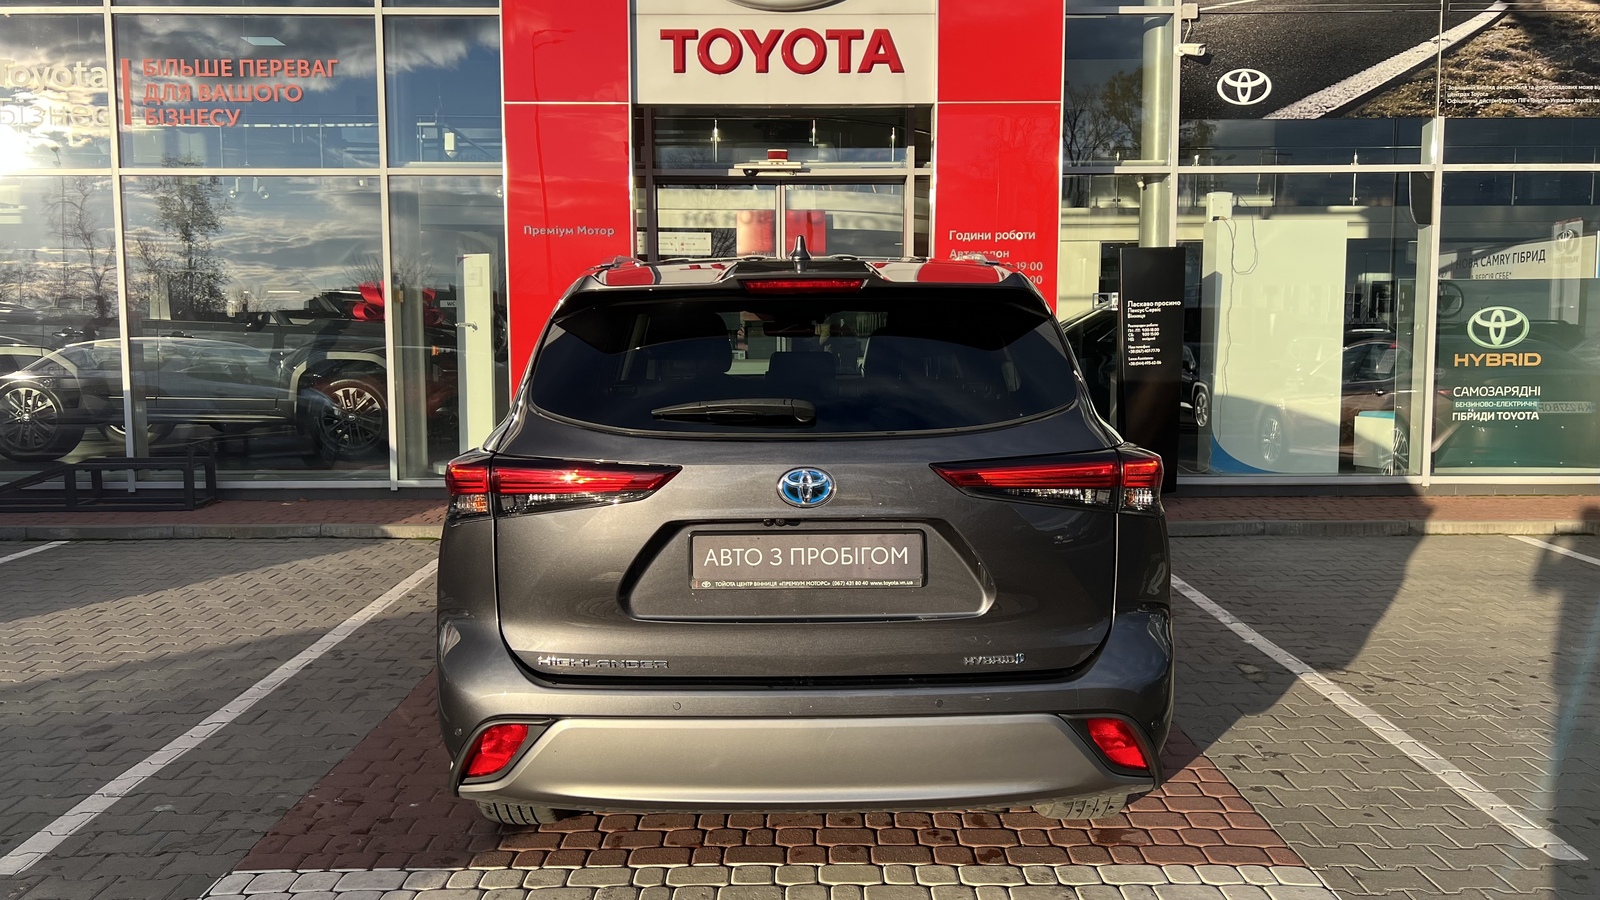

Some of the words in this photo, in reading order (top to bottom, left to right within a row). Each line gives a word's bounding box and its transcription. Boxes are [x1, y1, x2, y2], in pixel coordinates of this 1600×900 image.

[660, 28, 905, 75] TOYOTA
[142, 58, 233, 77] БІЛЬШЕ
[239, 59, 339, 77] ПЕРЕВАГ
[143, 83, 191, 105] ДЛЯ
[198, 84, 303, 102] ВАШОГО
[145, 108, 241, 127] БІЗНЕСУ
[523, 225, 574, 237] Преміум
[577, 226, 615, 237] Мотор
[949, 230, 992, 241] Години
[995, 229, 1036, 242] роботи
[1017, 262, 1043, 271] 19:00
[1456, 258, 1479, 270] НОВА
[1480, 253, 1510, 267] CAMRY
[1513, 249, 1546, 264] ГІБРИД
[1454, 352, 1542, 367] HYBRID
[1453, 385, 1541, 397] САМОЗАРЯДНІ
[1452, 411, 1495, 422] ГІБРИДИ
[1497, 411, 1540, 421] TOYOTA
[703, 548, 763, 567] АВТО
[769, 548, 783, 566] З
[790, 546, 908, 566] ПРОБІГОМ
[537, 655, 669, 669] HIGHLANDER
[963, 655, 1016, 665] HYBRID
